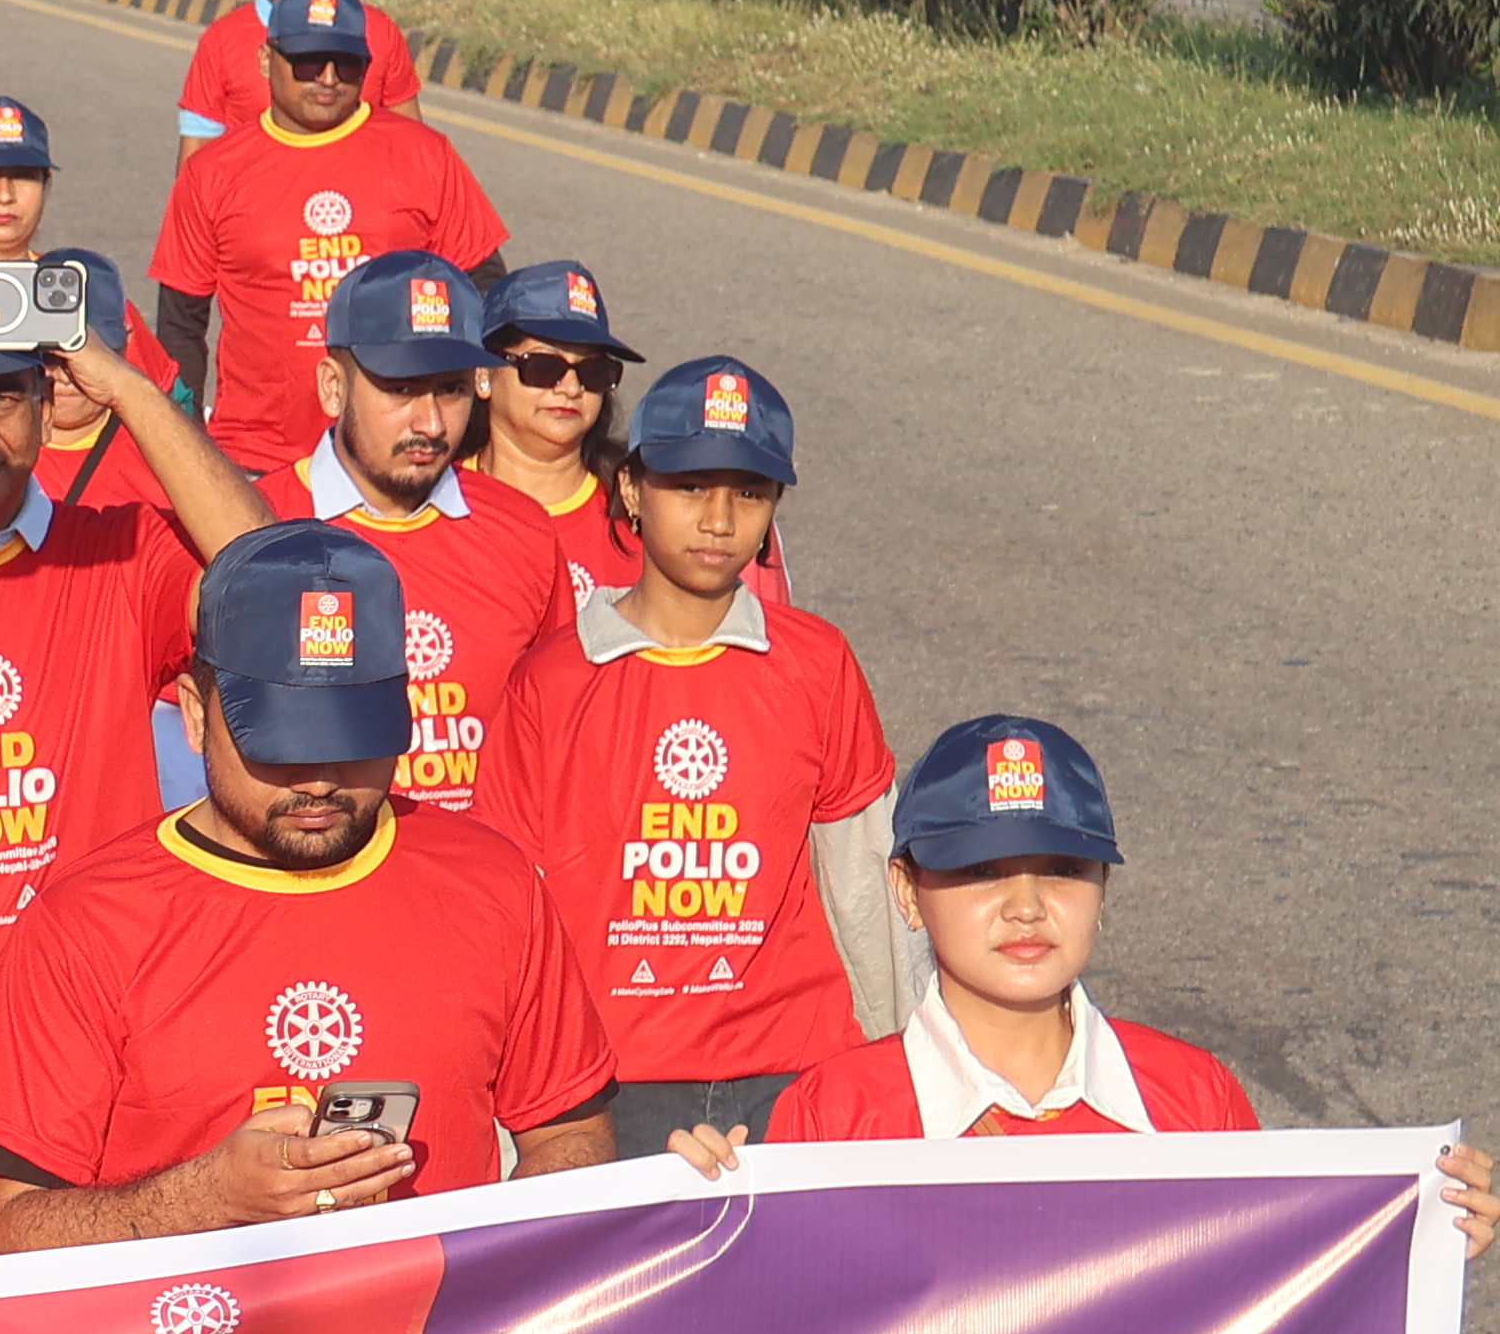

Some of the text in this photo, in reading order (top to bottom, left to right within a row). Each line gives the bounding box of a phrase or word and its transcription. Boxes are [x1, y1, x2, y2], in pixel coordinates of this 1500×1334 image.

[641, 803, 738, 840] END
[623, 841, 760, 879] POLIO
[632, 880, 748, 917] NOW
